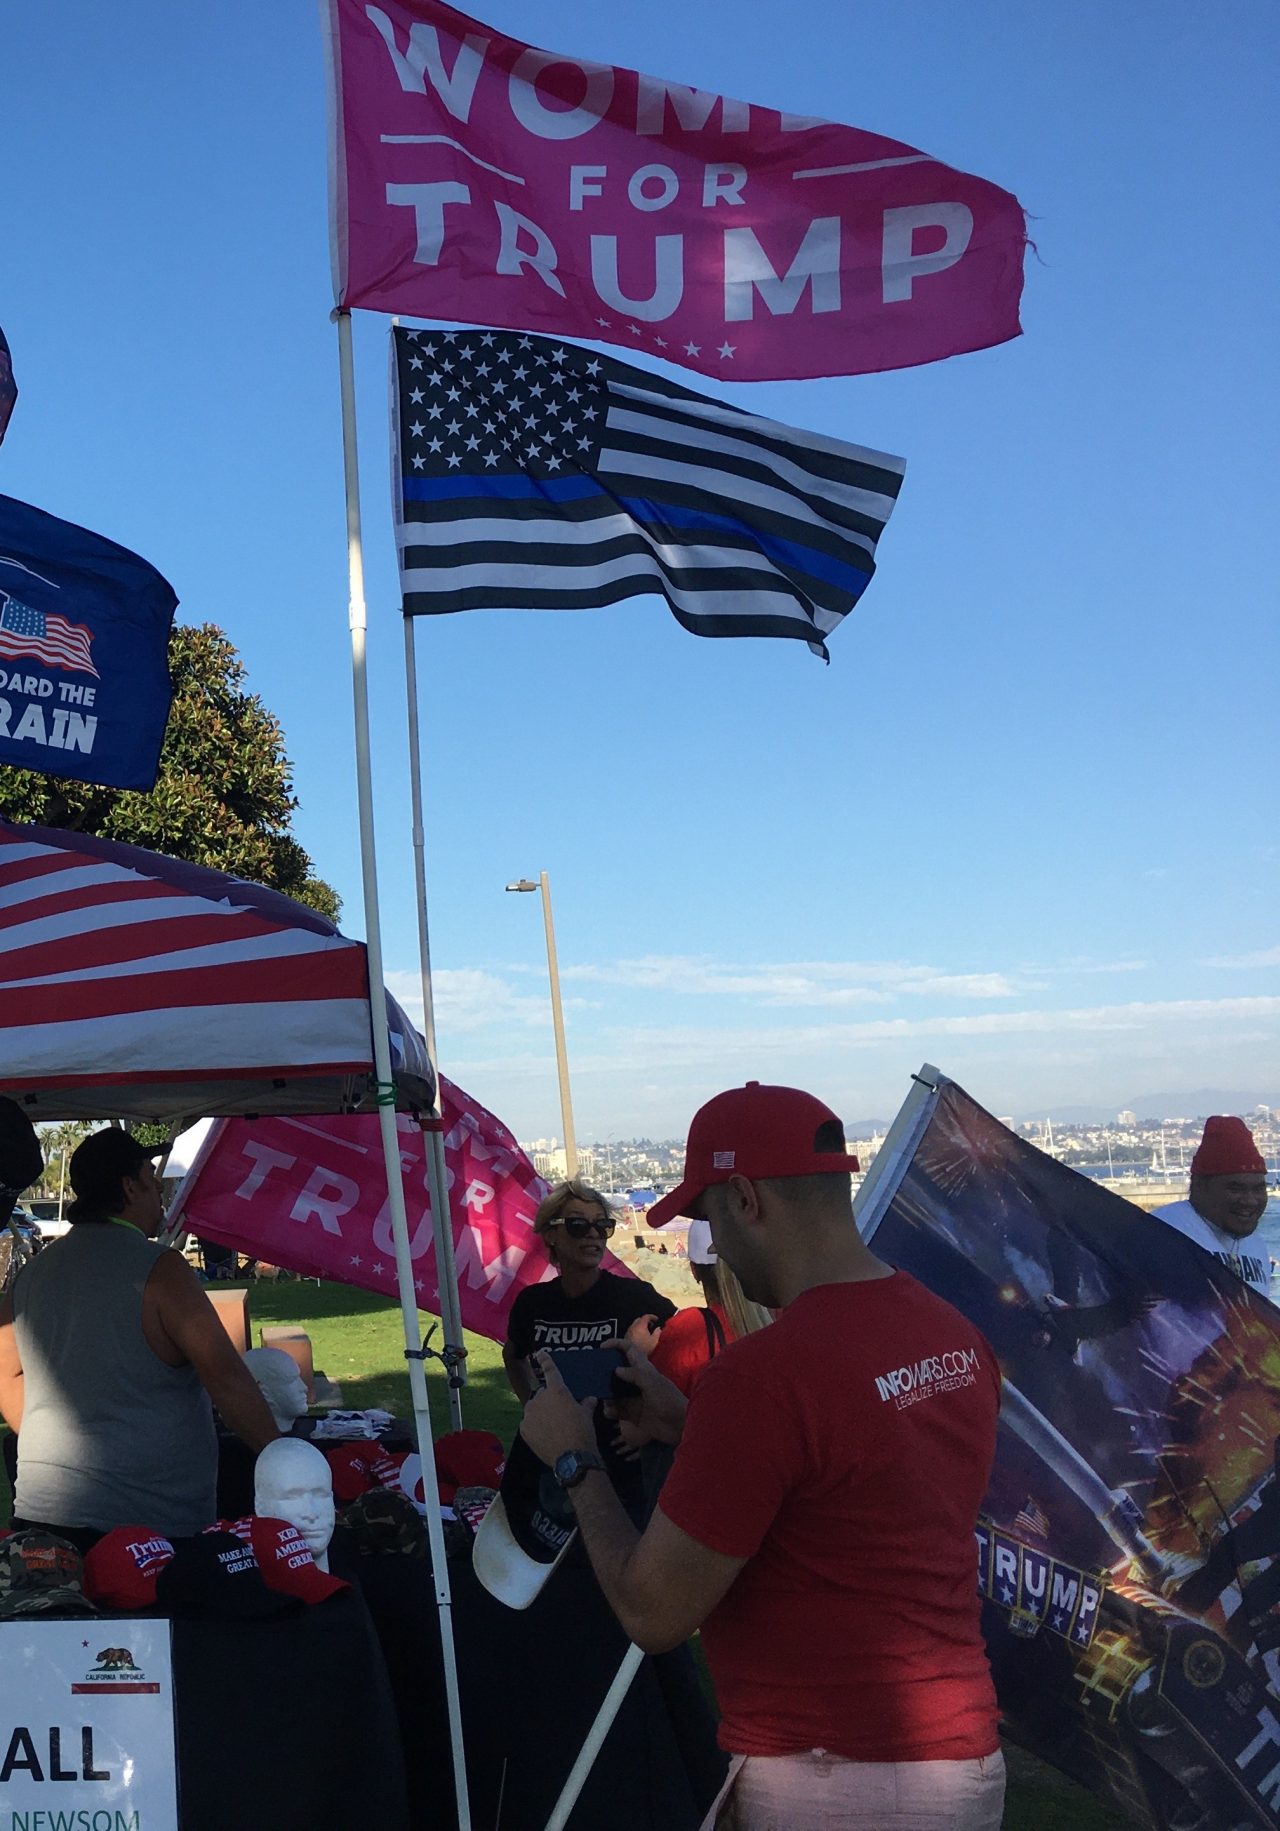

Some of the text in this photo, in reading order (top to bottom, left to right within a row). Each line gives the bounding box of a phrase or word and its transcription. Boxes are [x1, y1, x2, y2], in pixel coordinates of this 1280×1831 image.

[569, 163, 749, 211] FOR
[385, 182, 974, 322] TRUMP
[58, 682, 96, 707] THE
[234, 1139, 559, 1304] TRUM
[534, 1324, 612, 1344] TRUMP
[875, 1348, 980, 1401] INFOWARS.COM
[895, 1373, 977, 1411] LEGALIZE FREEDOM
[218, 1549, 241, 1563] MAKE
[227, 1558, 253, 1573] GREAT
[119, 1673, 146, 1681] REPUBLIC
[12, 1810, 141, 1831] NEWSOM
